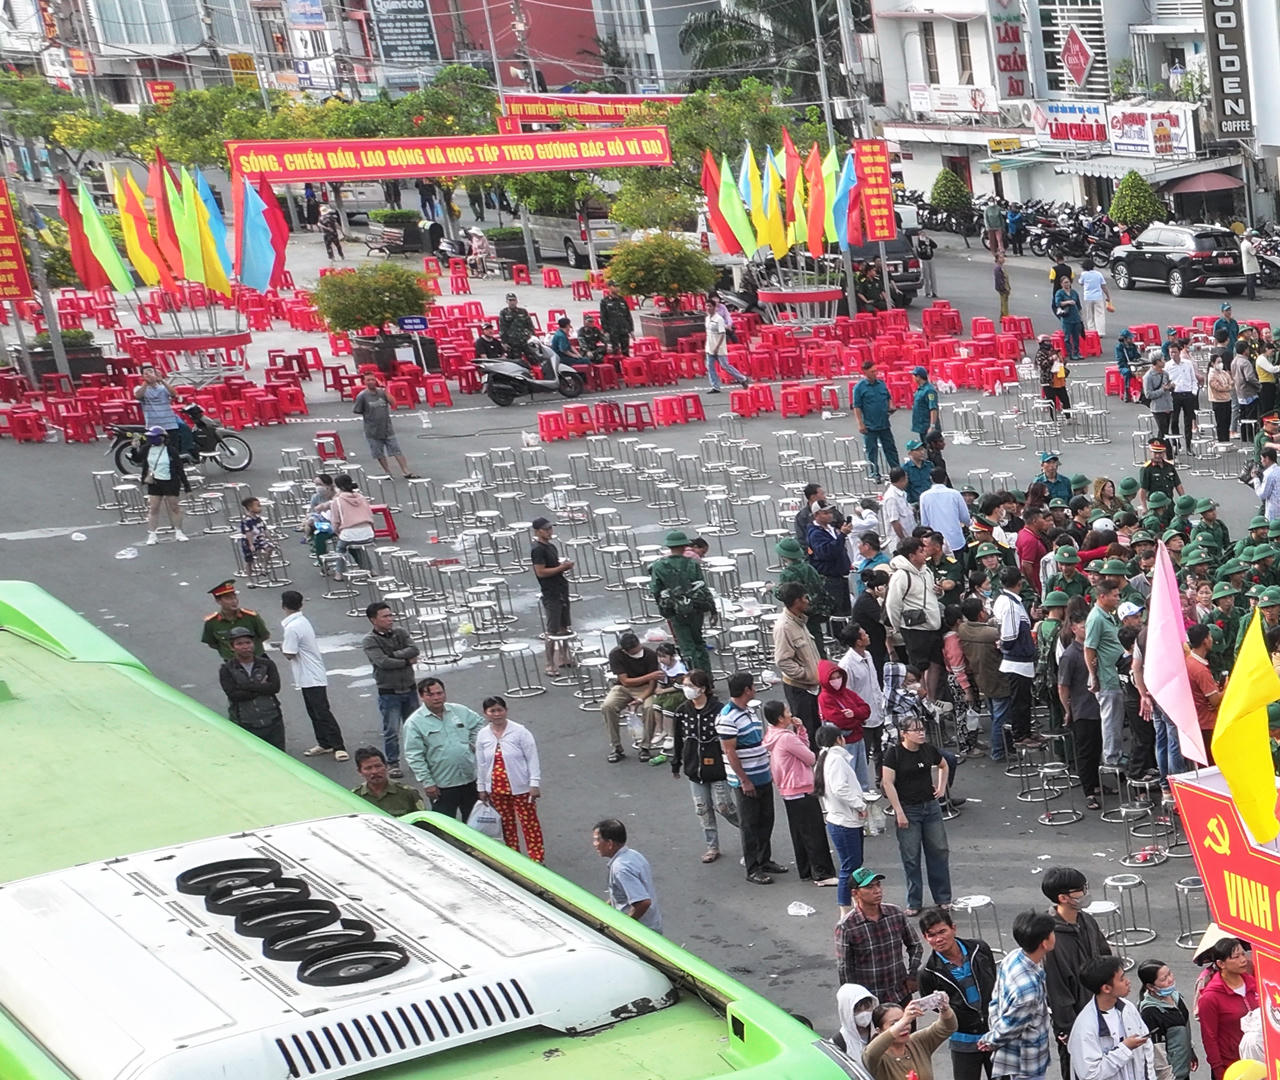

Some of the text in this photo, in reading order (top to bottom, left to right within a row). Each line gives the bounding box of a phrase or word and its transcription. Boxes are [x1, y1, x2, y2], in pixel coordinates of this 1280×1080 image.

[1221, 120, 1251, 132] COFFEE
[239, 150, 283, 173] SỐNG,
[361, 149, 386, 168] LAO
[386, 146, 426, 169] ĐỘNG
[426, 145, 446, 165] VÀ
[447, 146, 475, 166] HỌC
[475, 143, 500, 165] TẬP
[502, 144, 535, 161] THEO
[535, 140, 579, 159] GƯƠNG
[580, 140, 606, 158] BÁC
[607, 135, 625, 156] HỒ
[626, 137, 641, 155] VĨ
[643, 139, 663, 158] ĐẠI
[1223, 870, 1273, 932] VINH
